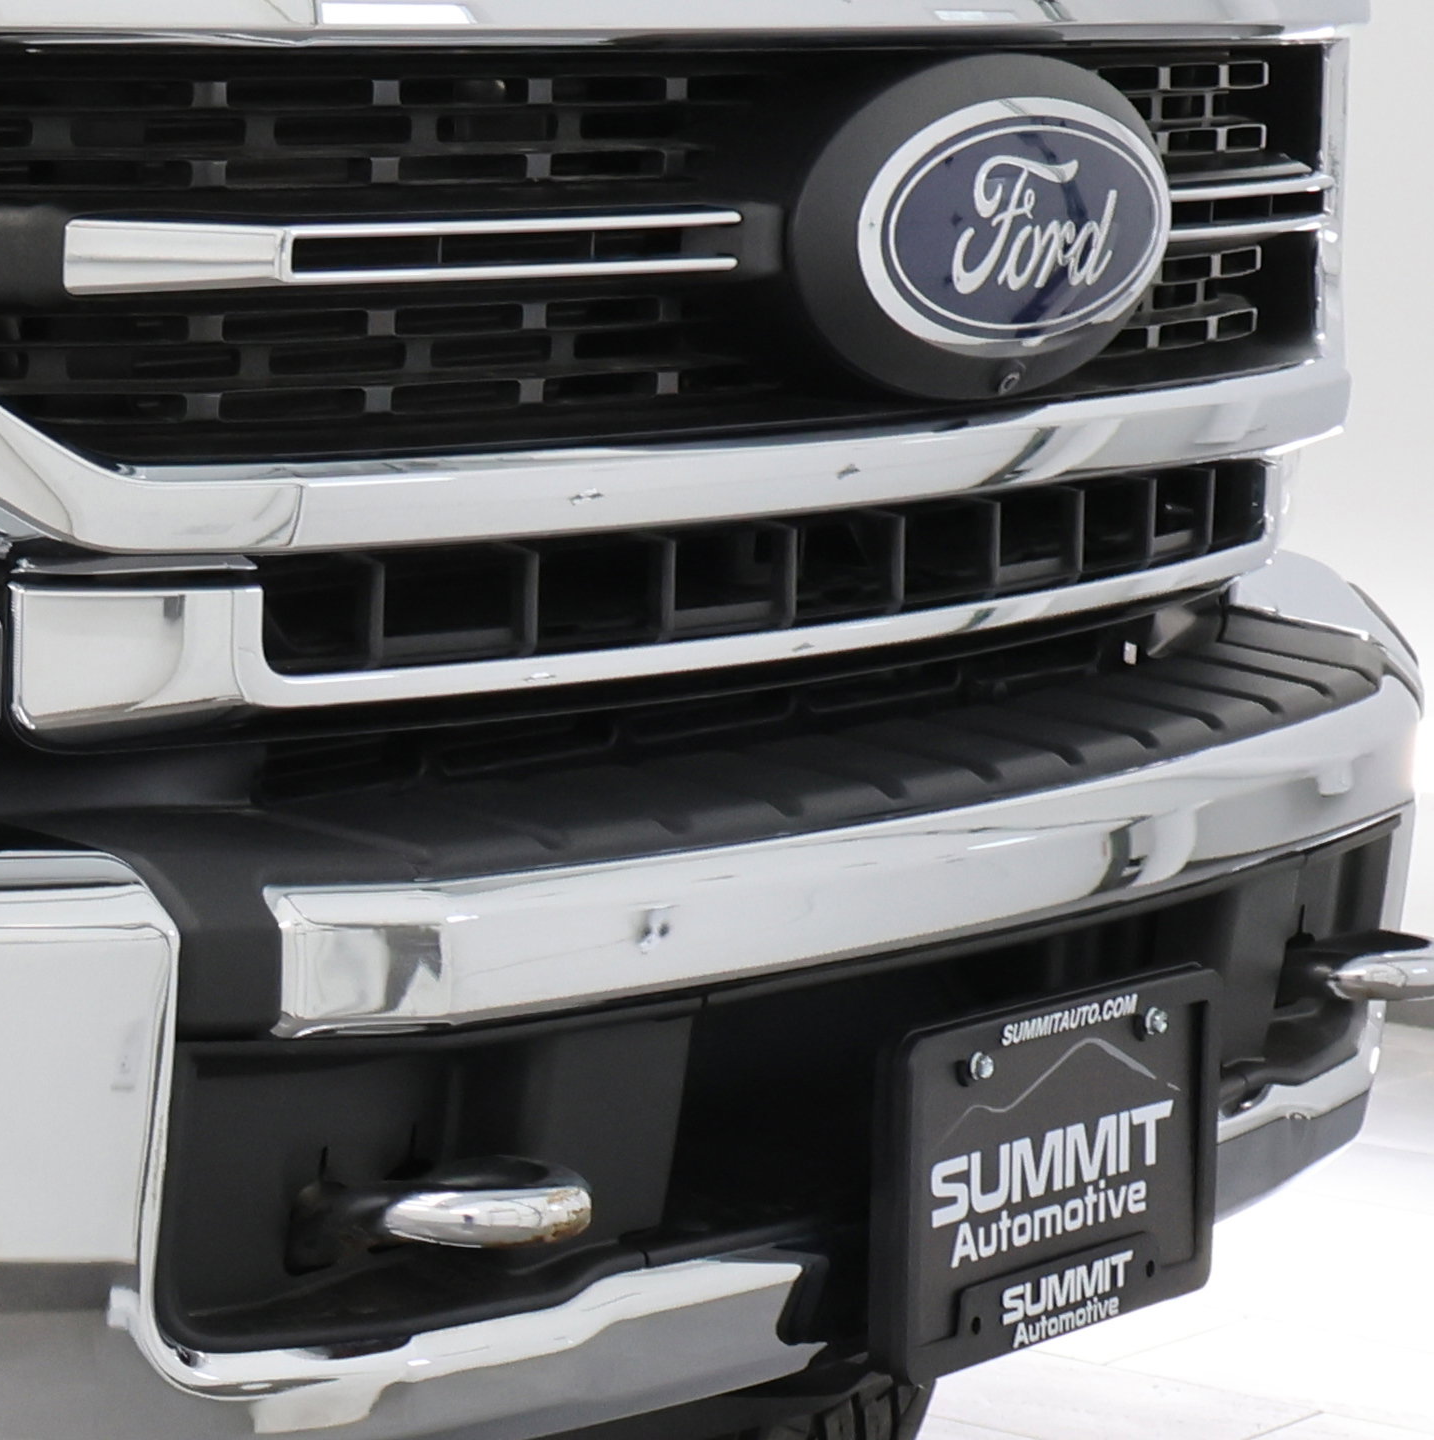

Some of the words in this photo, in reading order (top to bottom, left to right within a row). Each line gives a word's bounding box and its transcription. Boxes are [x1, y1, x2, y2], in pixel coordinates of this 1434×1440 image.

[951, 155, 1117, 295] Ford
[1001, 993, 1138, 1047] SUMMITAUTO.COM
[931, 1099, 1174, 1229] SUMMIT
[950, 1179, 1147, 1268] Automotive
[1002, 1250, 1134, 1325] SUMMIT
[1013, 1296, 1119, 1348] Automotive
